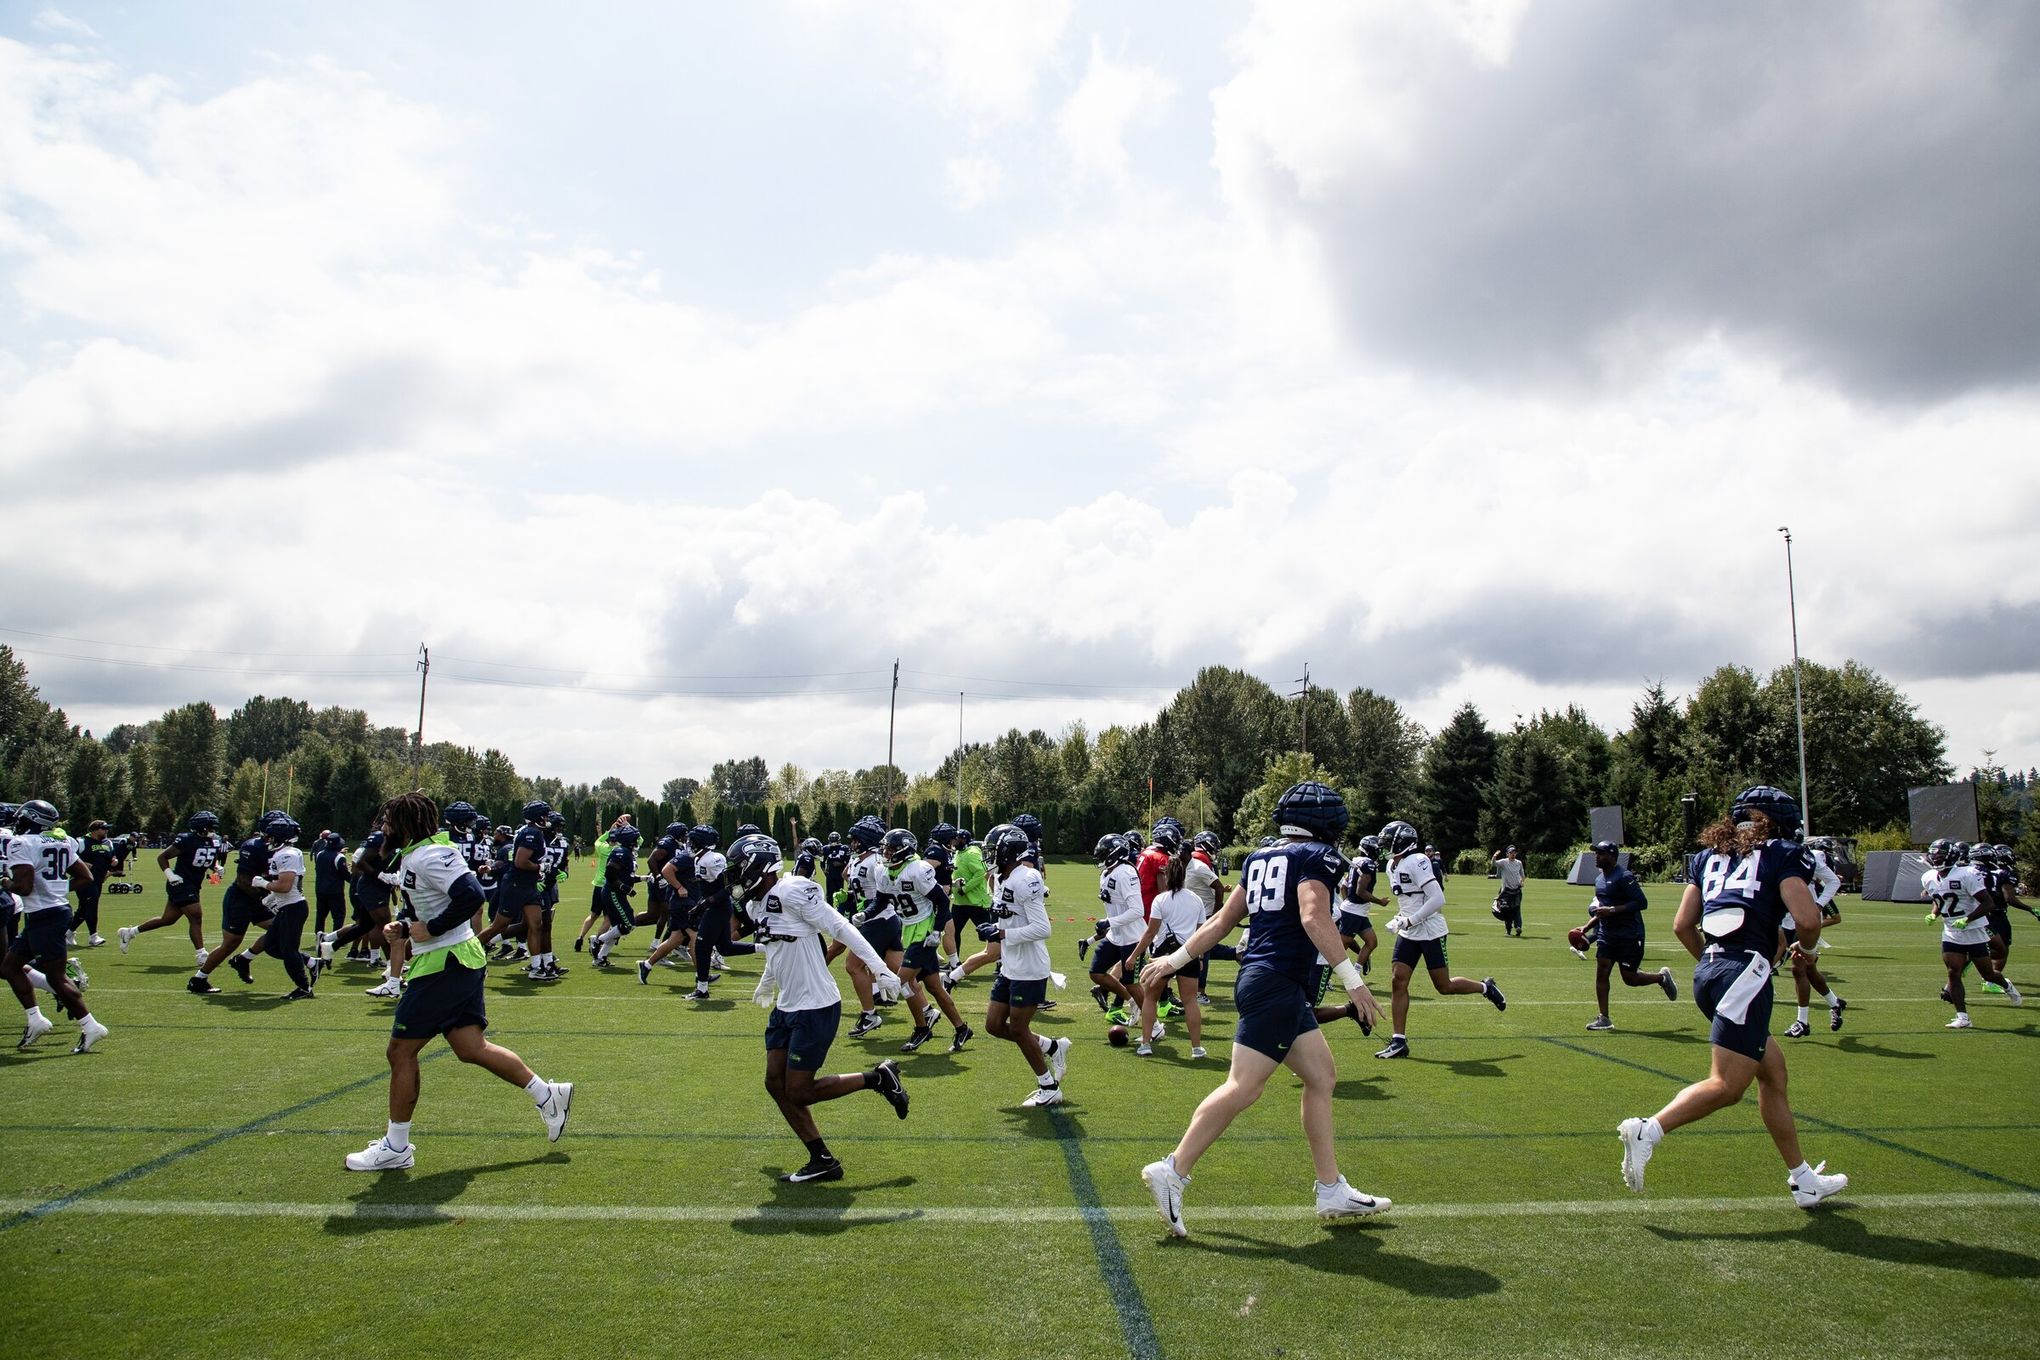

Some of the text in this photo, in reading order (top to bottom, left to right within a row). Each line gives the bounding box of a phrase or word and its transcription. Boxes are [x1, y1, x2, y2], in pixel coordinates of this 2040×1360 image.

[42, 848, 70, 880] 30
[192, 848, 216, 867] 65
[1246, 855, 1288, 914] 89
[1702, 850, 1762, 901] 84
[1932, 893, 1965, 917] 22
